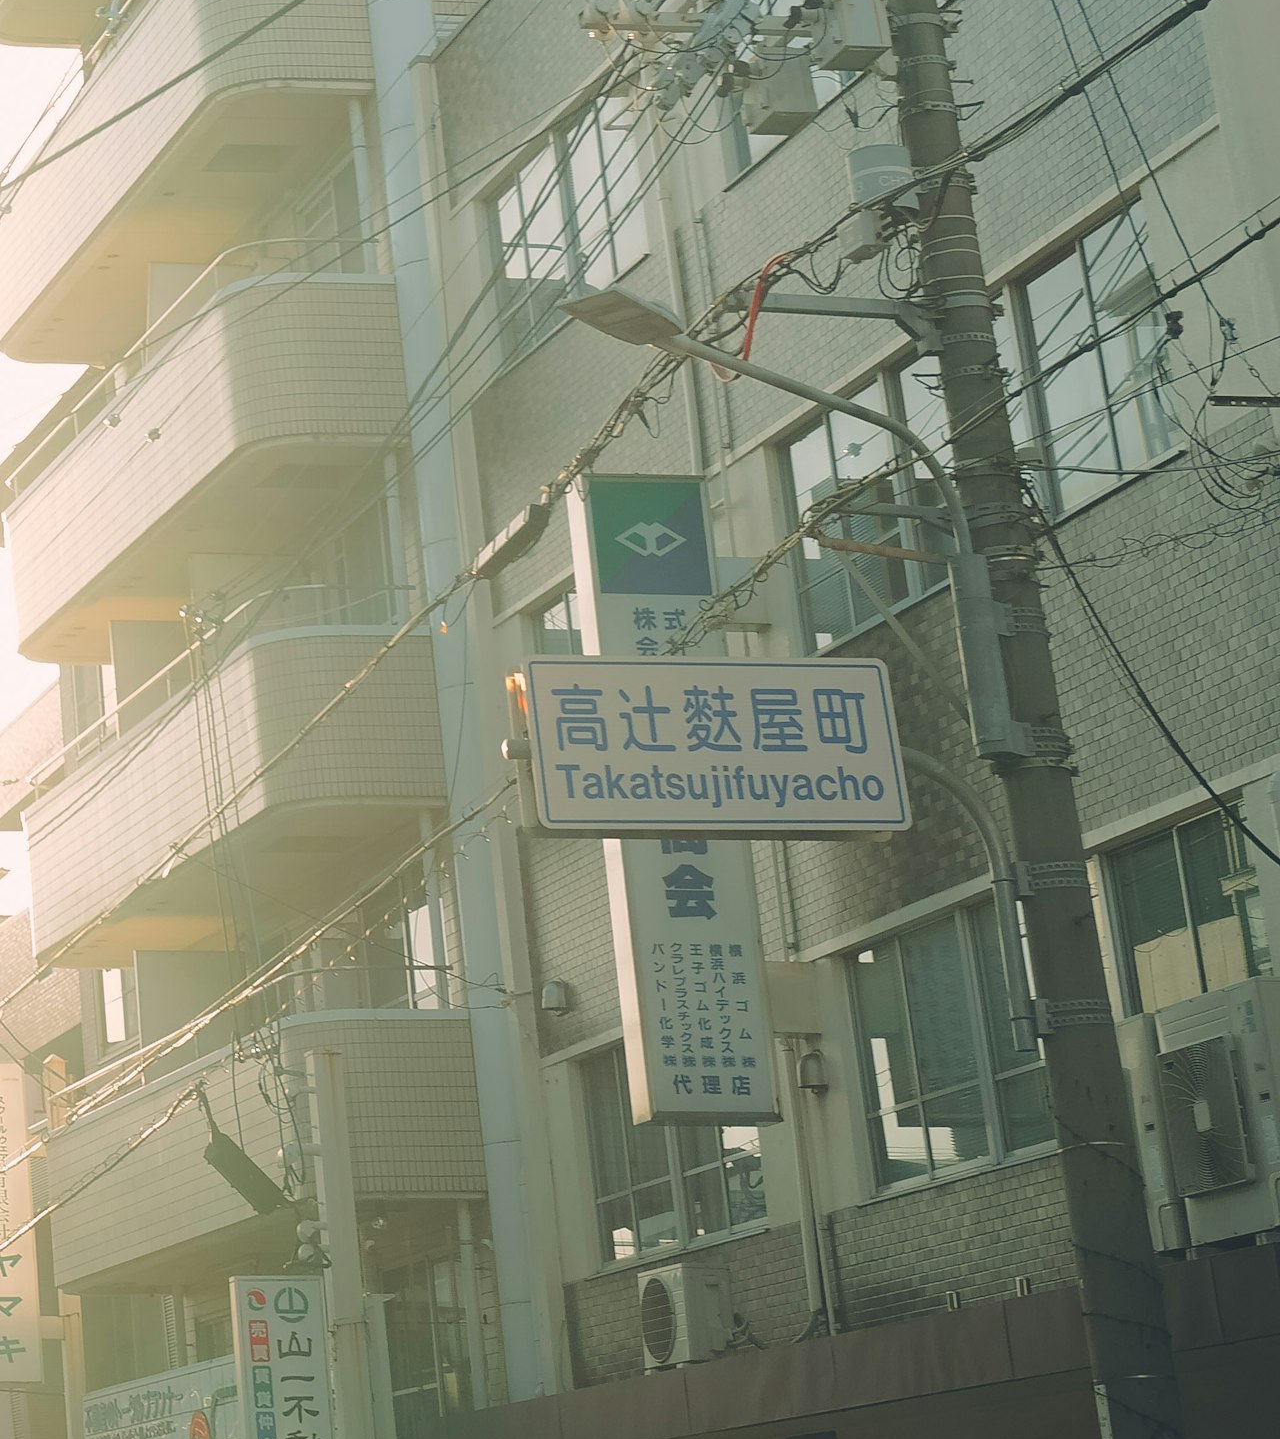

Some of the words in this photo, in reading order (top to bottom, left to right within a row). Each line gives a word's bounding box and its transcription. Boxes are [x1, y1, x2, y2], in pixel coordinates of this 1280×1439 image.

[633, 607, 687, 631] 株式
[556, 764, 885, 809] Takatsujifuyacho
[673, 1074, 751, 1096] 代理店
